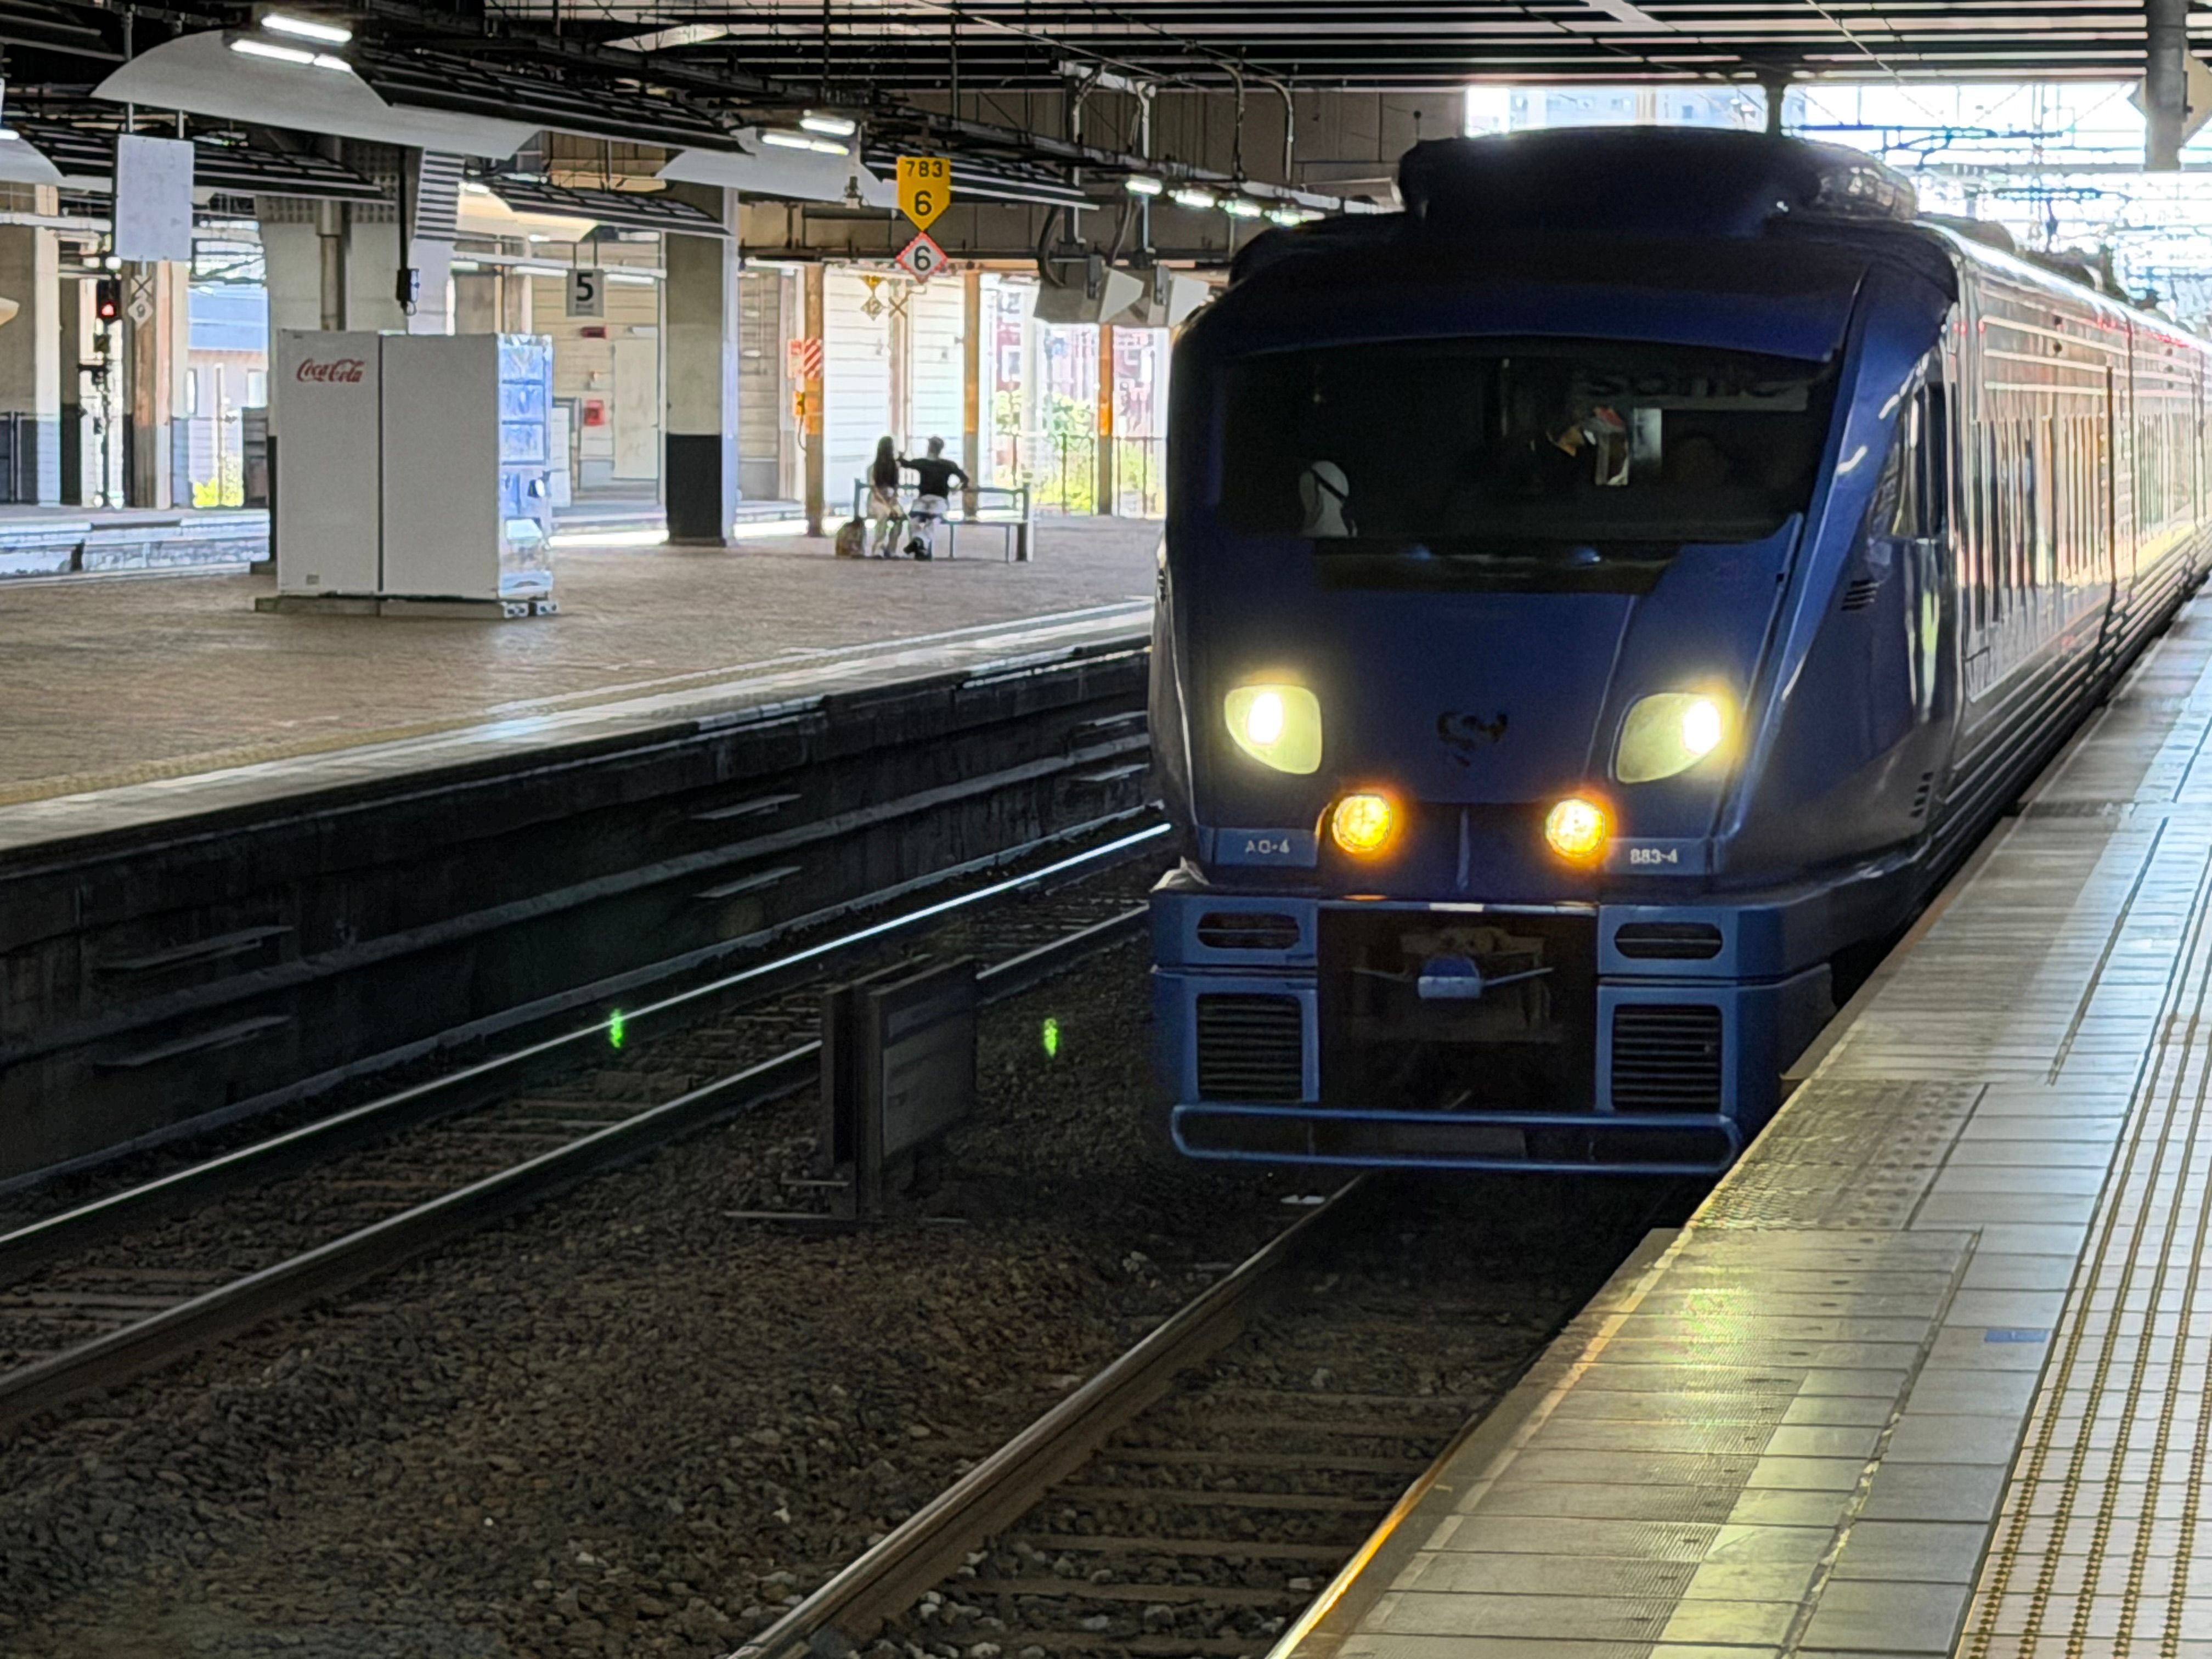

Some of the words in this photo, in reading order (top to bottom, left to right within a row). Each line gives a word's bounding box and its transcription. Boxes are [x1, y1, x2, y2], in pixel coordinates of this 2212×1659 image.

[906, 160, 943, 178] 783
[914, 190, 933, 216] 6
[914, 245, 932, 271] 6
[576, 272, 594, 302] 5
[1630, 848, 1678, 865] 883-4
